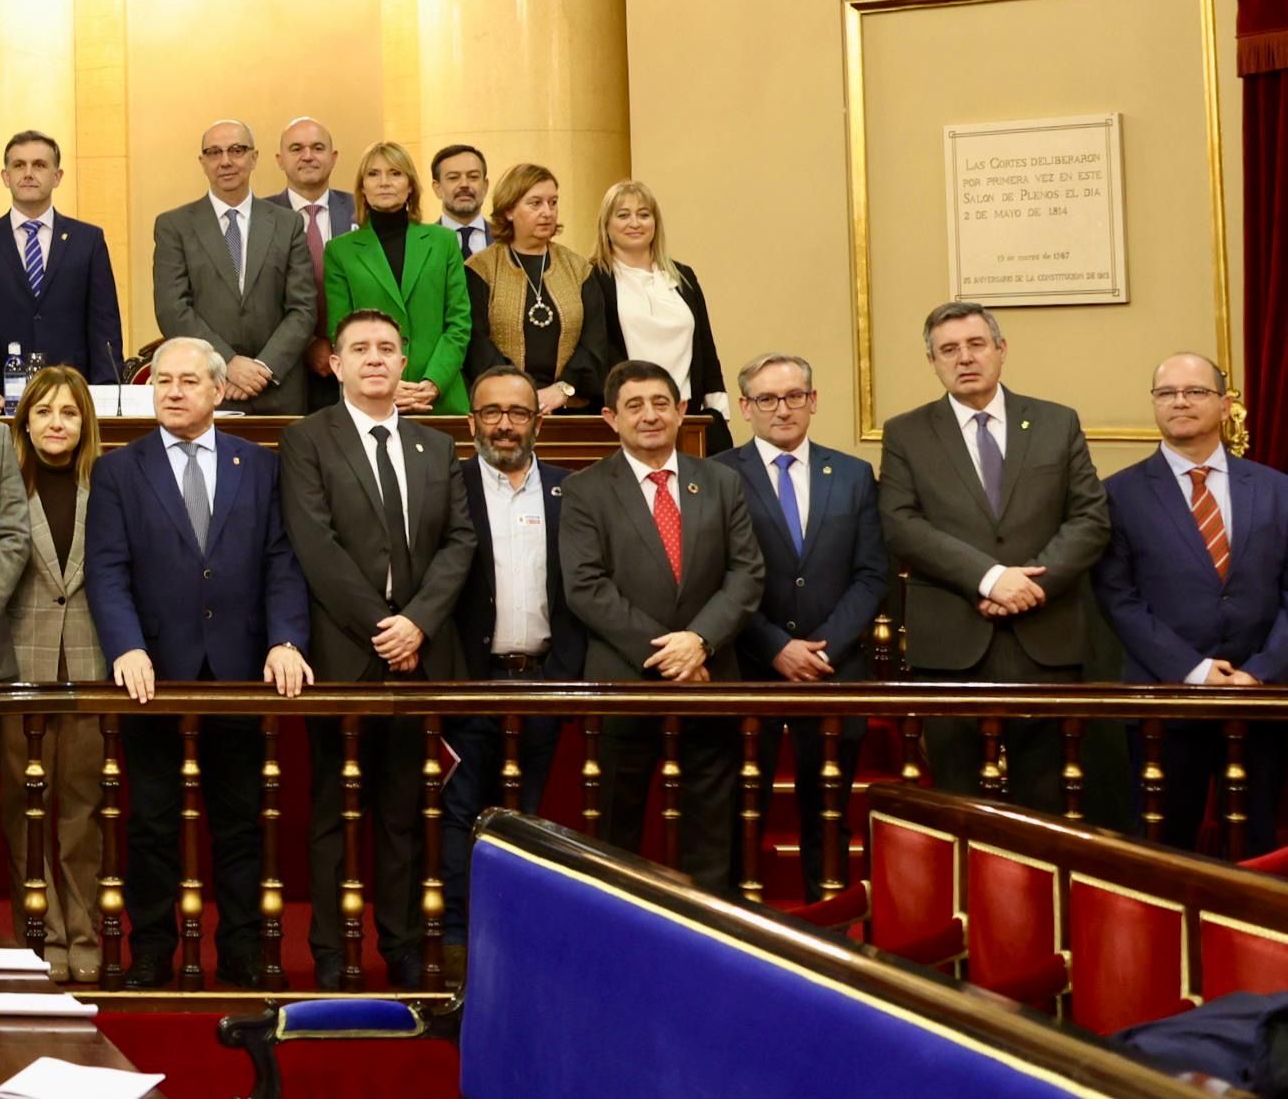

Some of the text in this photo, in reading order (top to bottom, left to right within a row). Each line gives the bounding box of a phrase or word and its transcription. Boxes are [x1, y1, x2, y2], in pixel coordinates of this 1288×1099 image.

[965, 153, 1101, 171] LAS CORTES DELIBERARON
[962, 169, 1102, 188] POR PRIMERA VEZ EN ESTE
[1001, 192, 1014, 202] DE
[1020, 188, 1059, 201] PLENOS
[1065, 188, 1079, 199] EL
[963, 206, 1068, 220] 2 DE MAYO DE 1814
